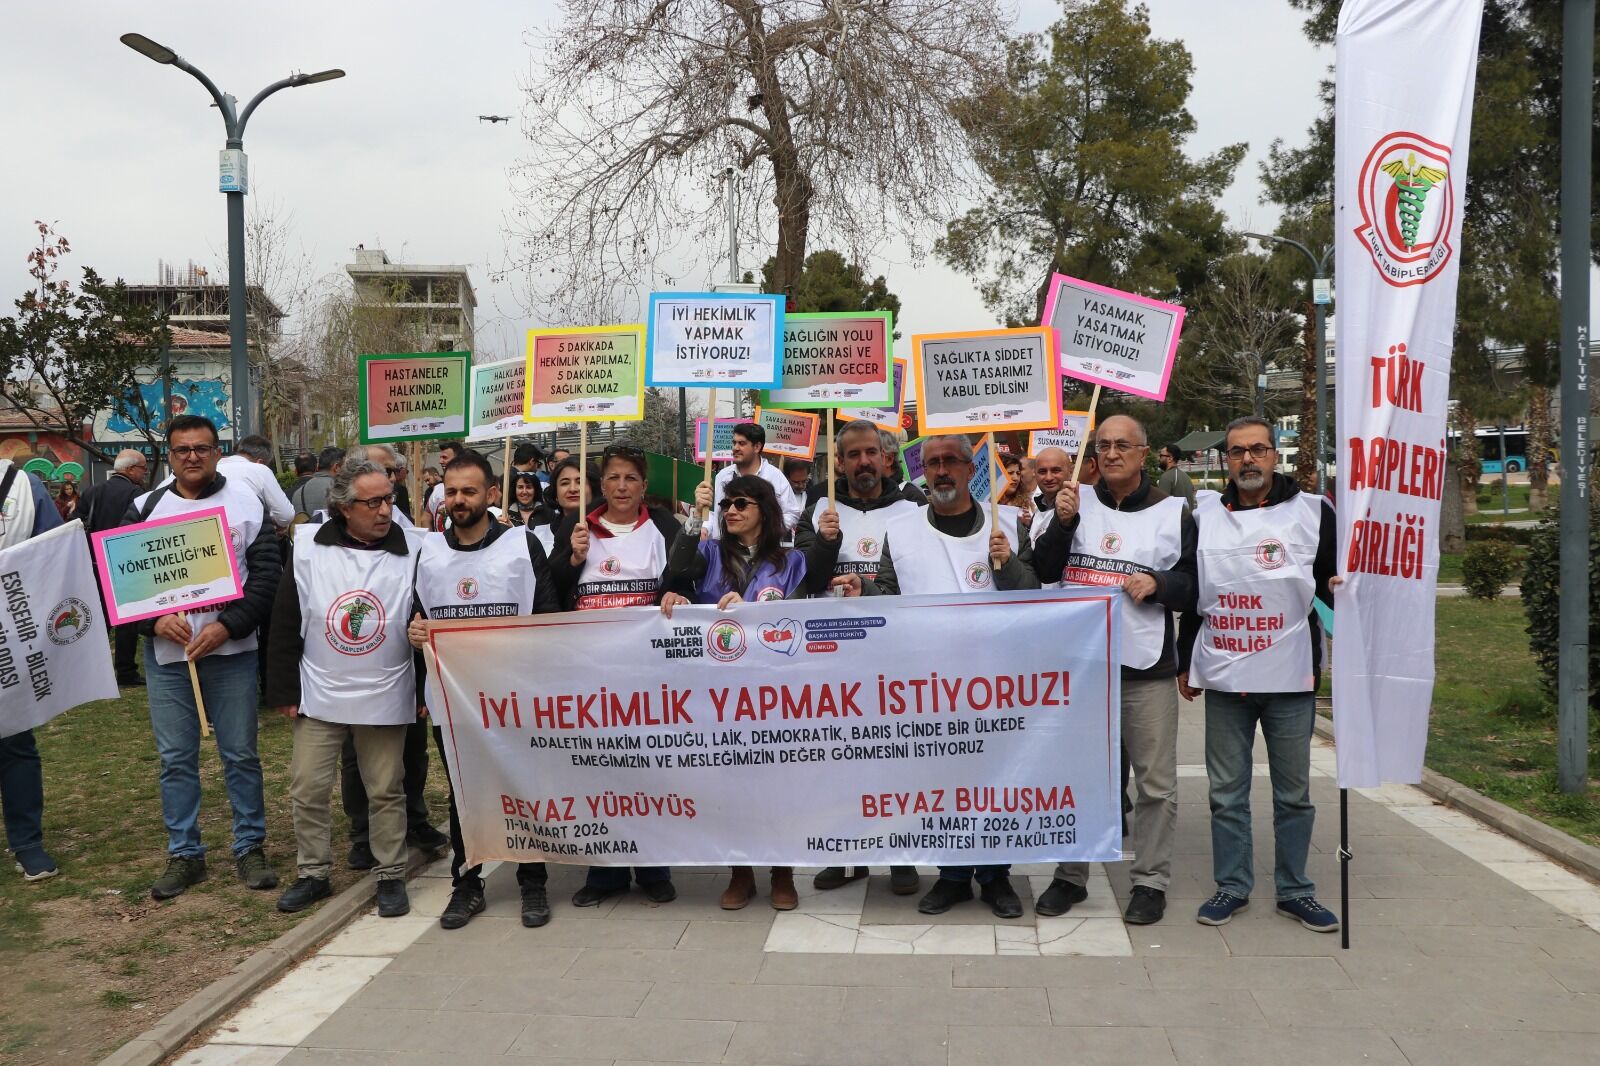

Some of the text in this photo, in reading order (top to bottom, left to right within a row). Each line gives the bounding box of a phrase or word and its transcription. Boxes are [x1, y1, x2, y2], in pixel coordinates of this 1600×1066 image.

[672, 305, 757, 321] İYİ HEKİMLİK
[685, 327, 744, 341] YAPMAK
[843, 330, 873, 341] YOLU
[558, 340, 614, 353] 5 DAKİKADA
[676, 343, 750, 360] İSTİYORUZ!
[784, 344, 871, 359] DEMOKRASİ VE
[1073, 330, 1140, 361] İSTİYORUZ!
[540, 353, 632, 368] HEKİMLİK YAPILMAZ,
[933, 349, 991, 366] SAĞLIKTA
[384, 366, 449, 381] HASTANELER
[557, 368, 613, 381] 5 DAKİKADA
[840, 363, 879, 376] GEÇER
[937, 364, 1033, 382] YASA TASARIMIZ
[507, 380, 515, 390] VE
[1371, 342, 1425, 414] TÜRK
[389, 383, 444, 397] HALKINDIR,
[550, 382, 619, 395] SAĞLIK OLMAZ
[943, 380, 1029, 398] KABUL EDİLSİN!
[386, 398, 447, 414] SATILAMAZ!
[1037, 437, 1082, 448] SUSMAYACA
[1347, 507, 1425, 580] BİRLİĞİ
[843, 562, 857, 573] BİR
[858, 562, 881, 573] SAĞLI
[1081, 555, 1094, 568] BİR
[1096, 558, 1123, 572] SAĞLIK
[153, 567, 189, 585] HAYIR
[1075, 570, 1088, 582] BİR
[587, 582, 599, 594] BİR
[601, 581, 629, 593] SAĞLIK
[597, 595, 636, 608] HEKİMLİK
[1217, 592, 1263, 610] TÜRK
[444, 604, 456, 618] BİR
[458, 604, 488, 618] SAĞLIK
[488, 603, 517, 616] SİSTEMİ
[1, 570, 38, 643] ESKİŞEHİR
[25, 650, 52, 702] BİLECİK
[673, 624, 702, 637] TÜRK
[651, 635, 702, 648] TABİPLERİ
[1213, 634, 1273, 653] BİRLİĞİ
[478, 670, 1070, 729] İYİ HEKİMLİK YAPMAK İSTİYORUZ!
[530, 716, 1026, 750] ADALETİN HAKİM OLDUĞU, LAİK, DEMOKRATİK, BARIŞ İÇİNDE BİR ÜLKEDE
[571, 739, 984, 769] EMEĞİMİZİN VE MESLEĞİMİZİN DEĞER GÖRMESİNİ İSTİYORUZ
[500, 791, 697, 823] BEYAZ YÜRÜYÜŞ
[861, 785, 1076, 818] BEYAZ BULUŞMA
[504, 818, 609, 839] 11-14 MART 2026
[921, 813, 1076, 832] 14 MART 2026 / 13.00
[506, 834, 639, 856] DİYARBAKIR-ANKARA
[807, 827, 1076, 853] HACETTEPE ÜNİVERSİTESİ TIP FAKÜLTESİ
